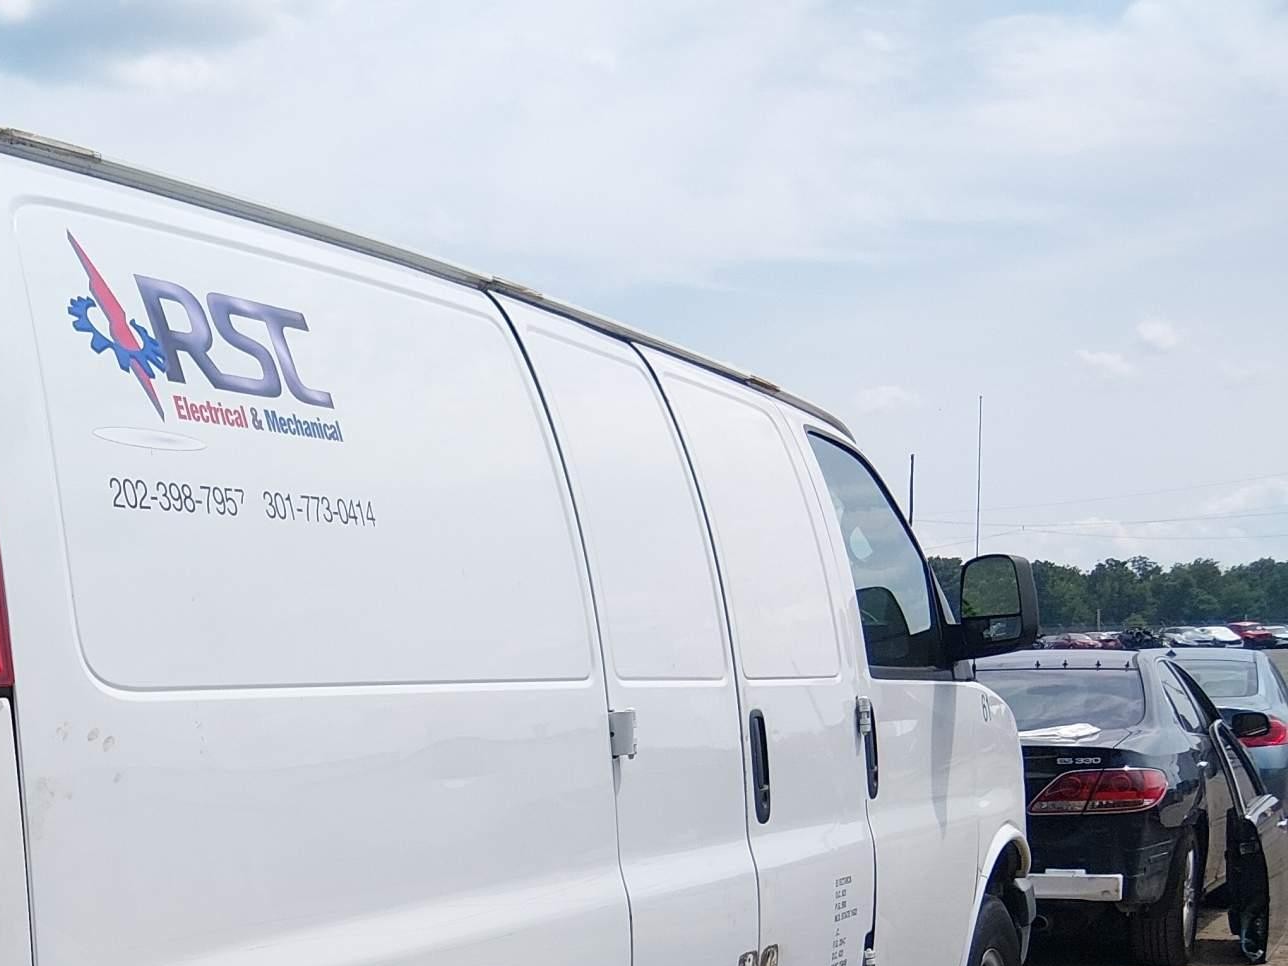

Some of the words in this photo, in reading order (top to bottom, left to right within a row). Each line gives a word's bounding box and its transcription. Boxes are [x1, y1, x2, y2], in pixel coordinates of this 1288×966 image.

[172, 395, 249, 428] Electrical
[250, 407, 264, 430] &
[264, 409, 344, 442] Mechanical
[109, 477, 245, 516] 202-398-7957
[262, 491, 376, 527] 301-773-0414
